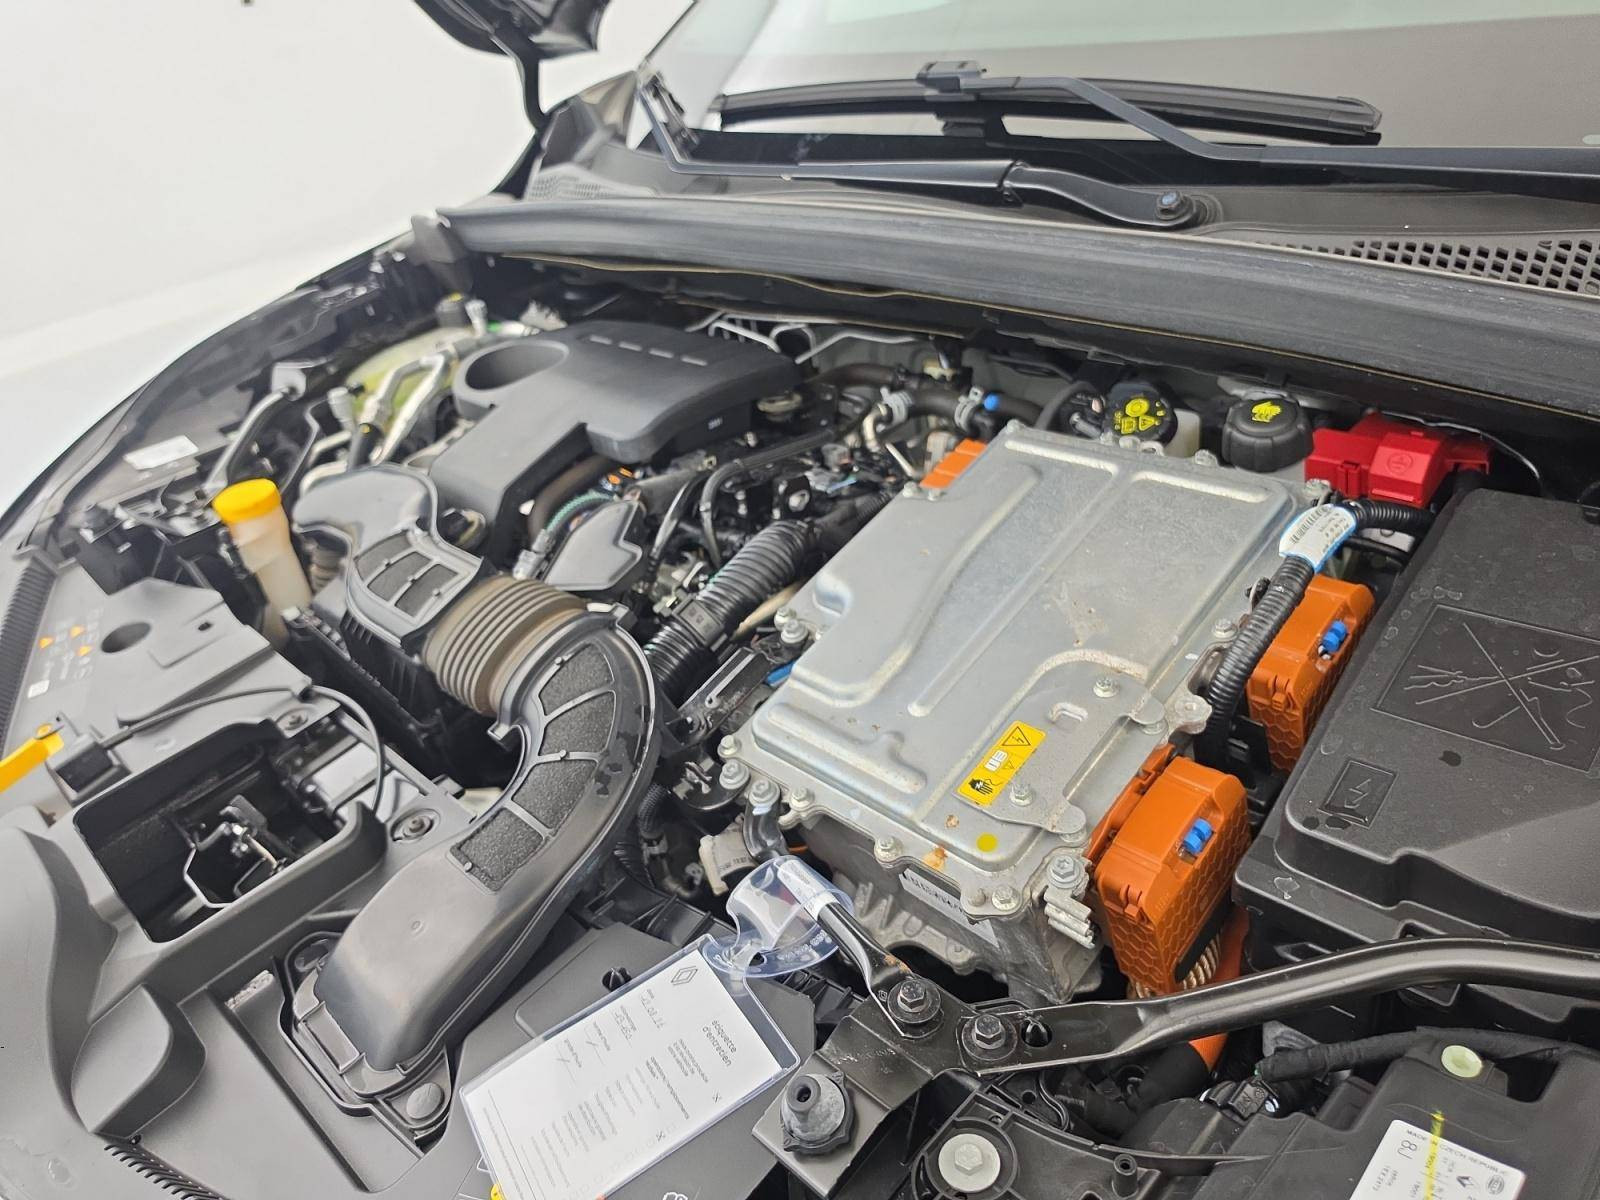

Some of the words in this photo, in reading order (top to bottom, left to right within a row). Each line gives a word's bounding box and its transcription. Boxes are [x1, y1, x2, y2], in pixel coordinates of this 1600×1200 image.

[702, 1026, 732, 1067] d'entretien
[1397, 1139, 1418, 1160] 8J
[1406, 1129, 1428, 1141] MADE
[1439, 1143, 1467, 1159] CZECH
